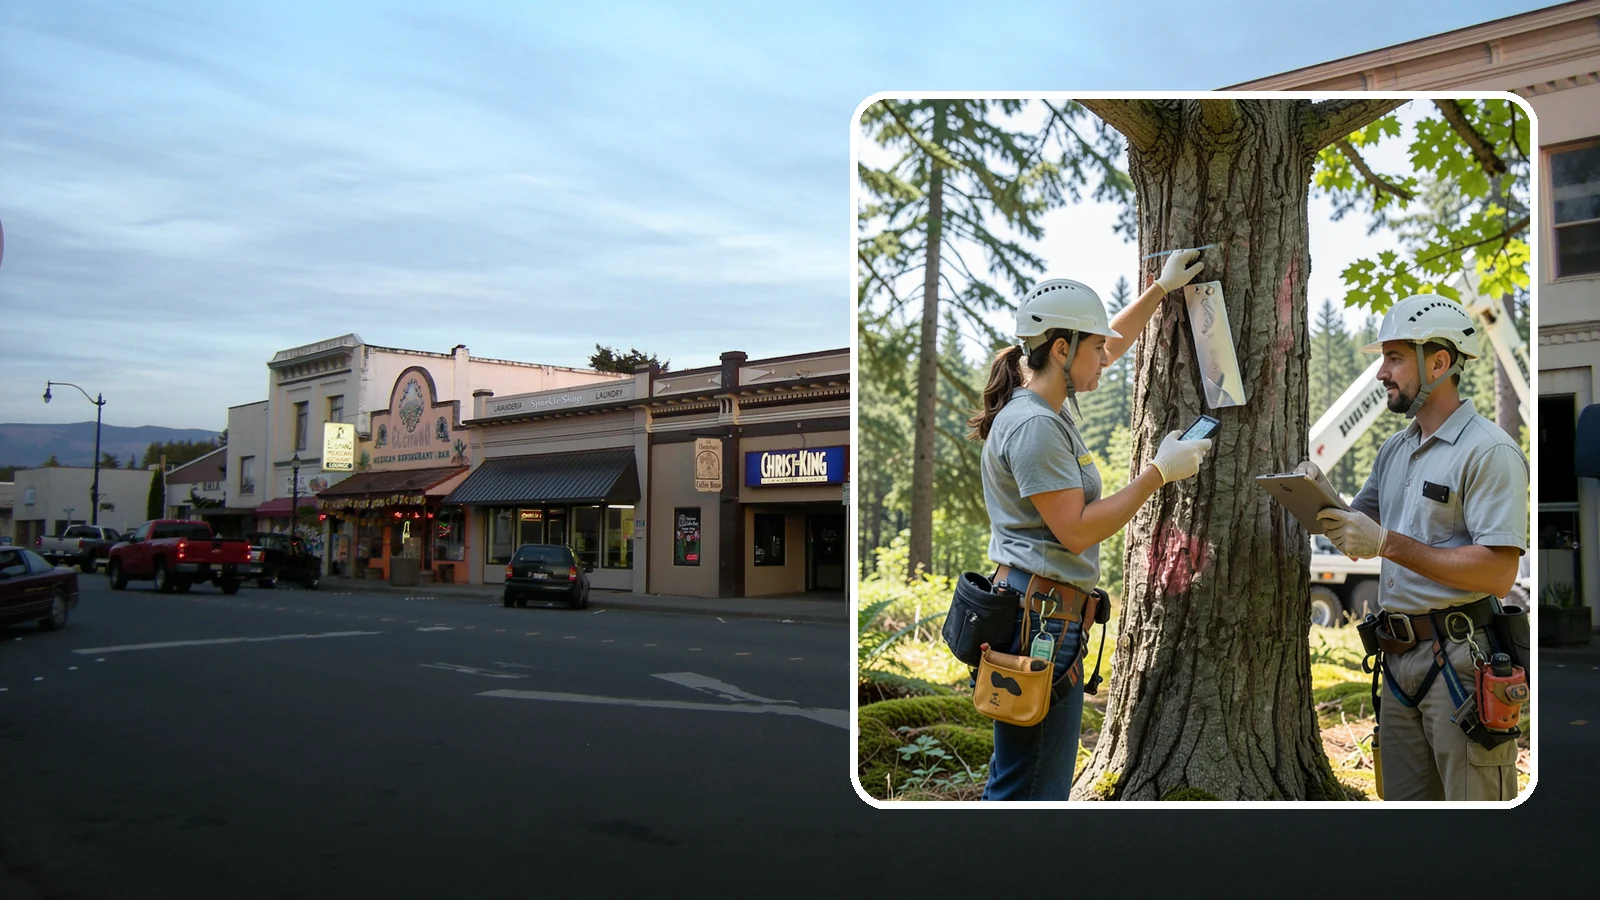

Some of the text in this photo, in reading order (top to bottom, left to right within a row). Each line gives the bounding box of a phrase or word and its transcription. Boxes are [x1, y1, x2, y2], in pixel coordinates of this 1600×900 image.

[596, 389, 623, 400] LAUNDRY
[493, 402, 522, 412] LAVANDERIA
[531, 395, 582, 408] Sparkle Shop
[373, 455, 396, 464] MEXICAN
[398, 451, 433, 462] RESTAURANT
[438, 450, 450, 459] BAR
[760, 450, 827, 478] CHRIST KING
[696, 480, 722, 489] Coffee House
